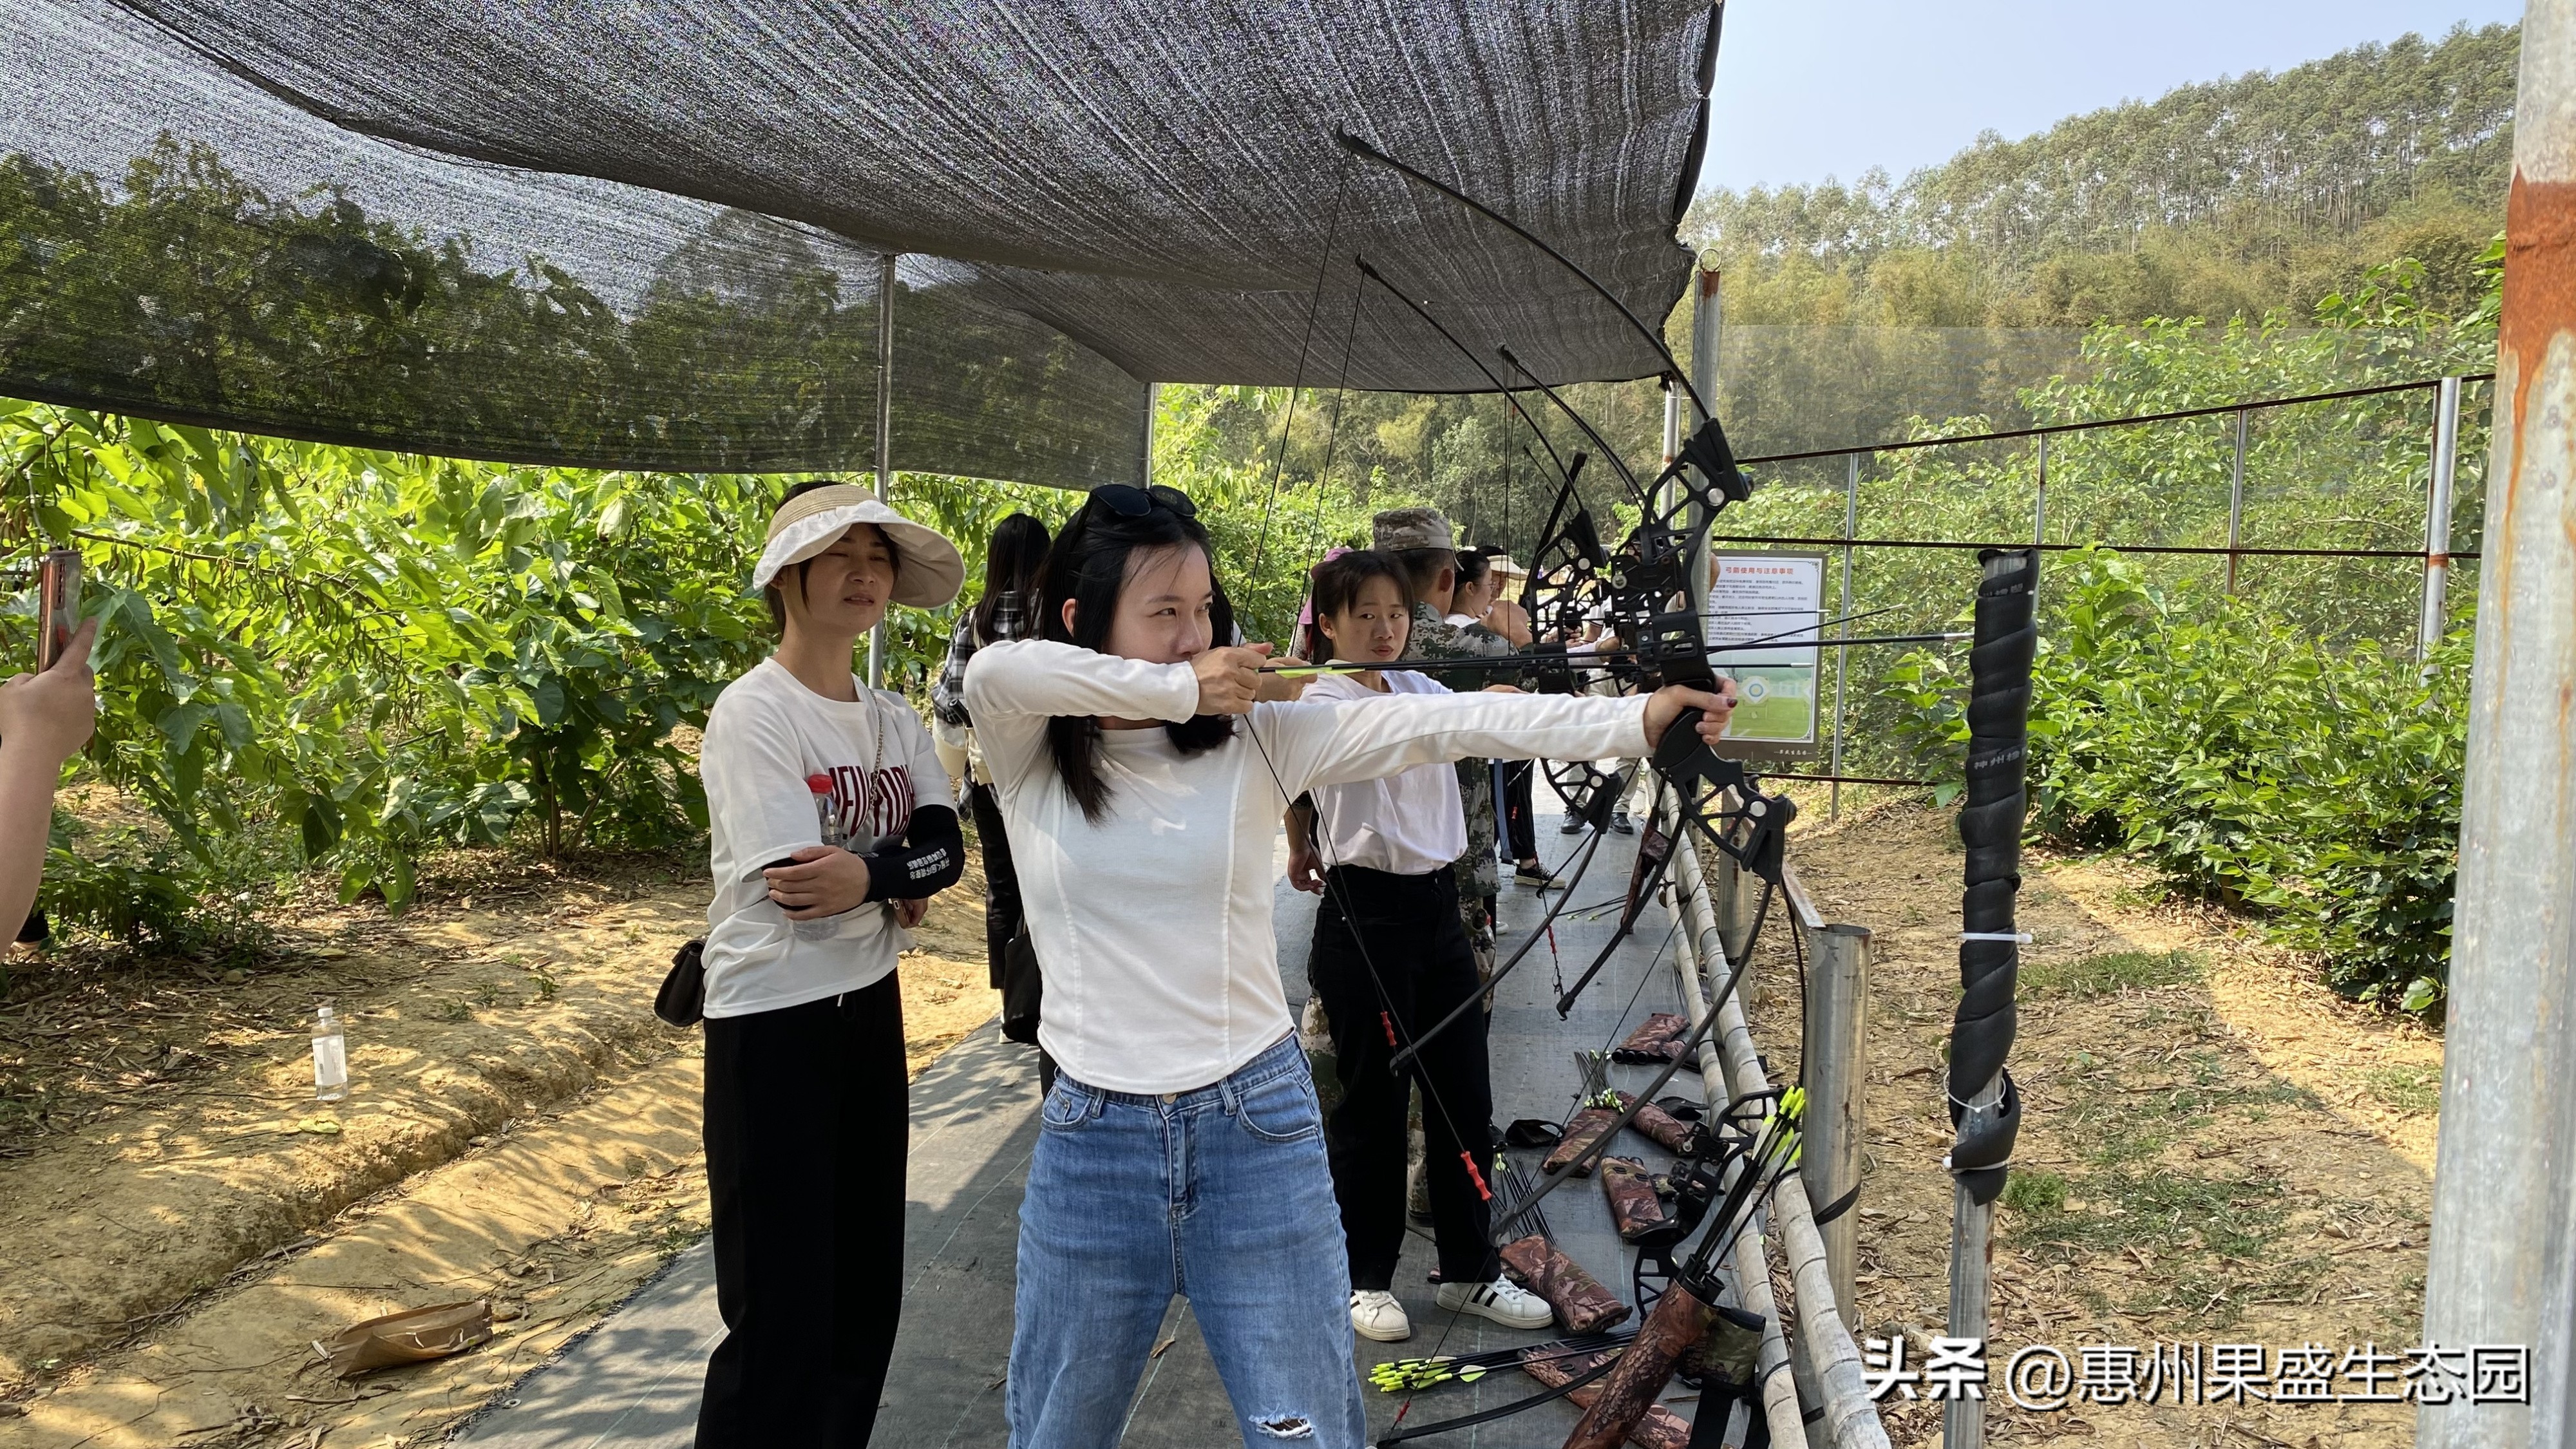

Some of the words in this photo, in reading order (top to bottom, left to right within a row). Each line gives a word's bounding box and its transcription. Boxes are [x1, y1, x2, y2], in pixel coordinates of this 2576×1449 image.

[1725, 567, 1794, 575] 弓箭使用与注意事项
